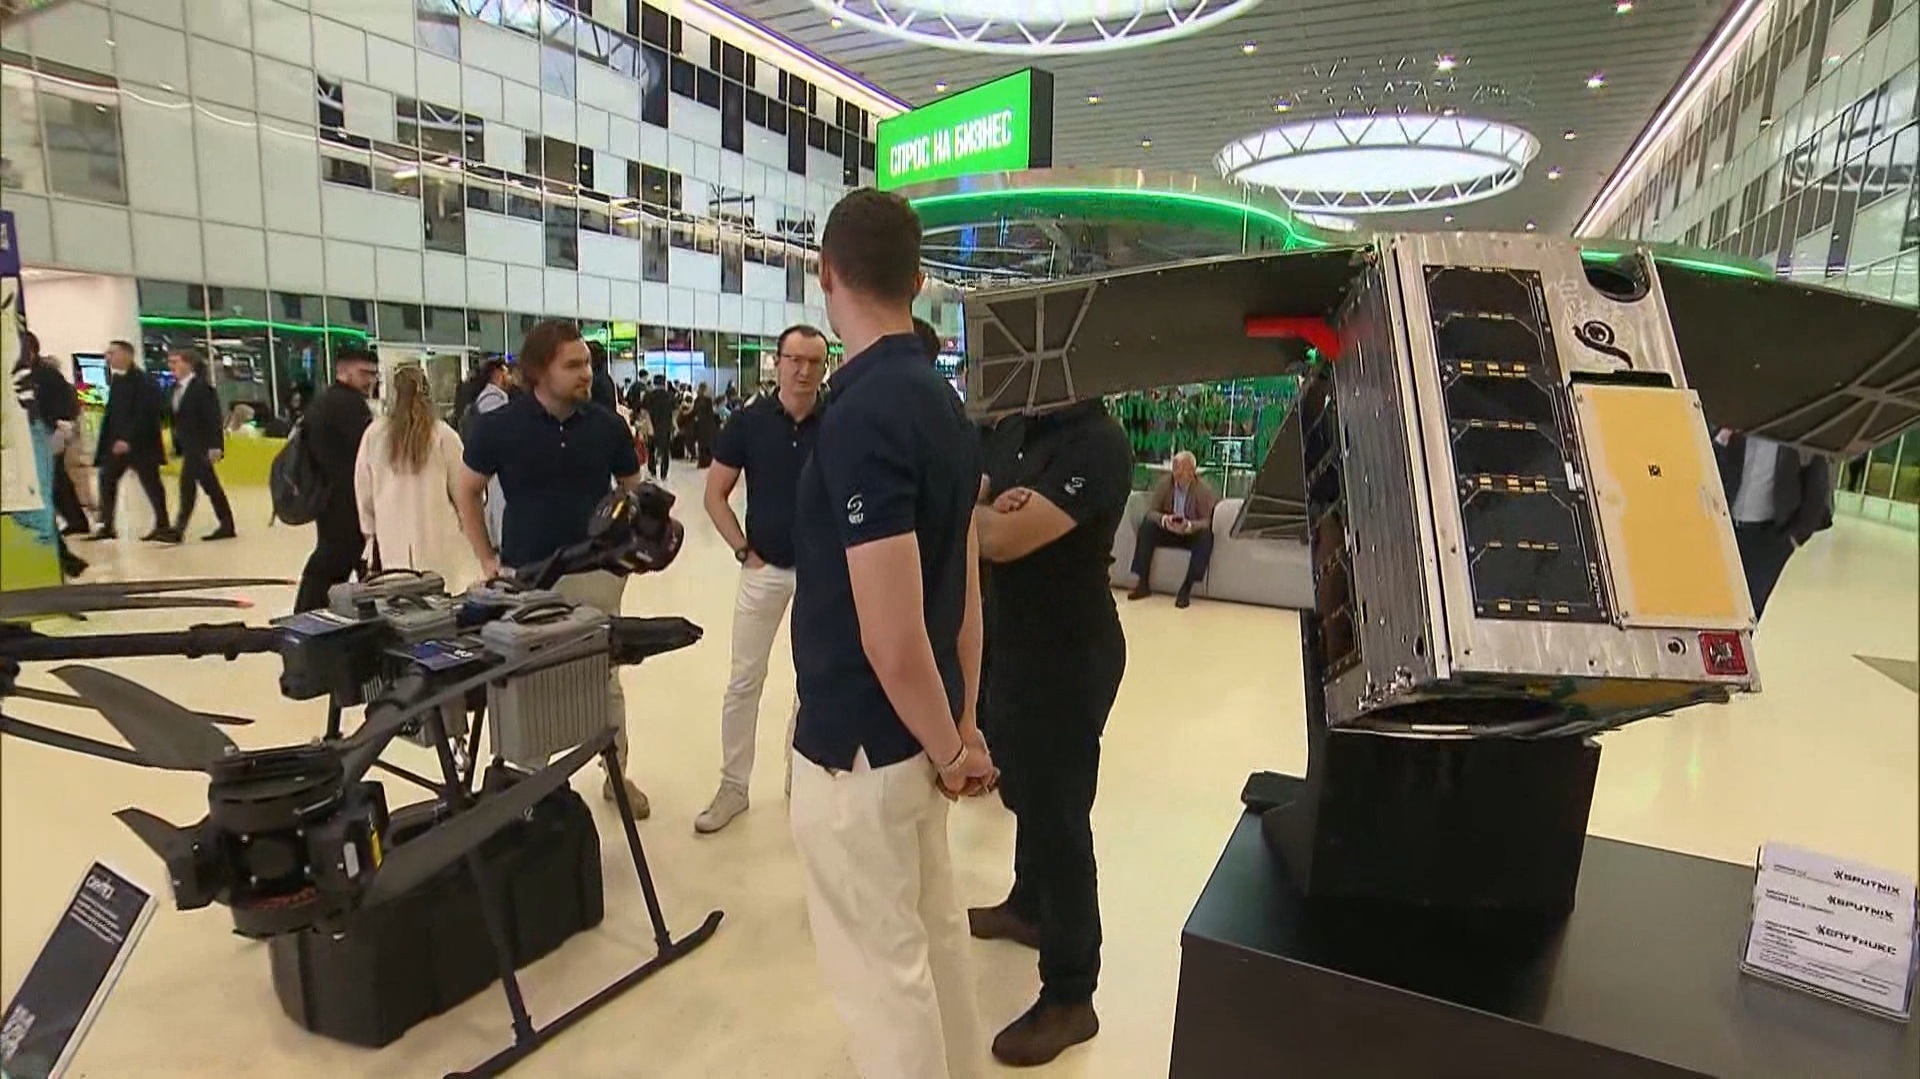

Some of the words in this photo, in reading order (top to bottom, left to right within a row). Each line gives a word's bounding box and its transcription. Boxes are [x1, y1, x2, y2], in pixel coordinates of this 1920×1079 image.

[890, 135, 930, 177] СПРОС
[933, 129, 951, 165] НА
[954, 110, 1012, 160] БИЗНЕС
